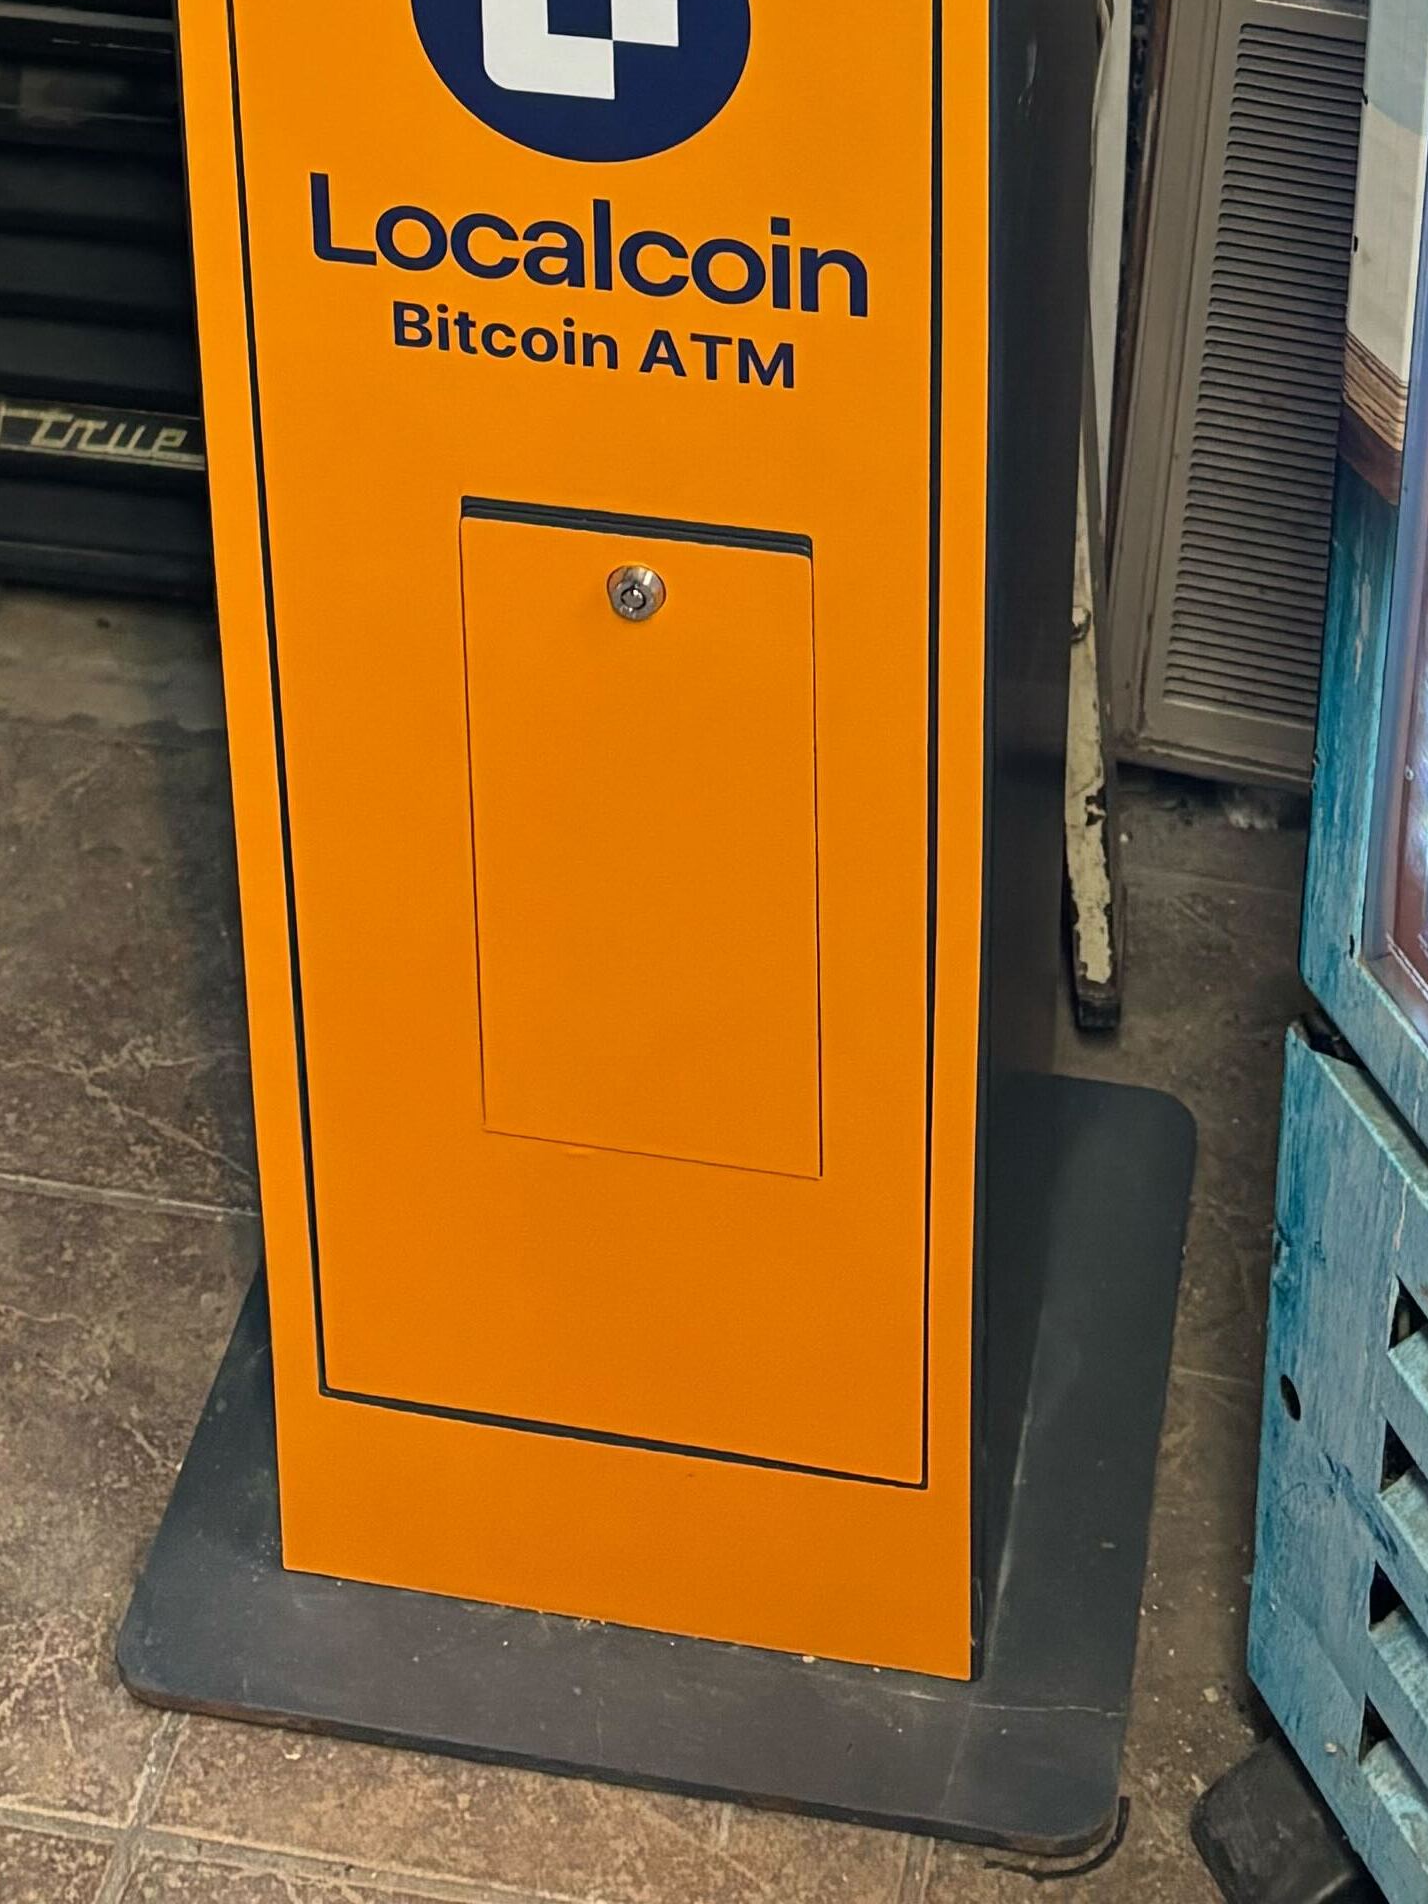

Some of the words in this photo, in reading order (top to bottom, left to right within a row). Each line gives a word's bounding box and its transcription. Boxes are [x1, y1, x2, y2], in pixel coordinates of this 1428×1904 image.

[309, 171, 869, 319] Localcoin
[391, 299, 620, 372] Bitcoin
[638, 328, 796, 390] ATM
